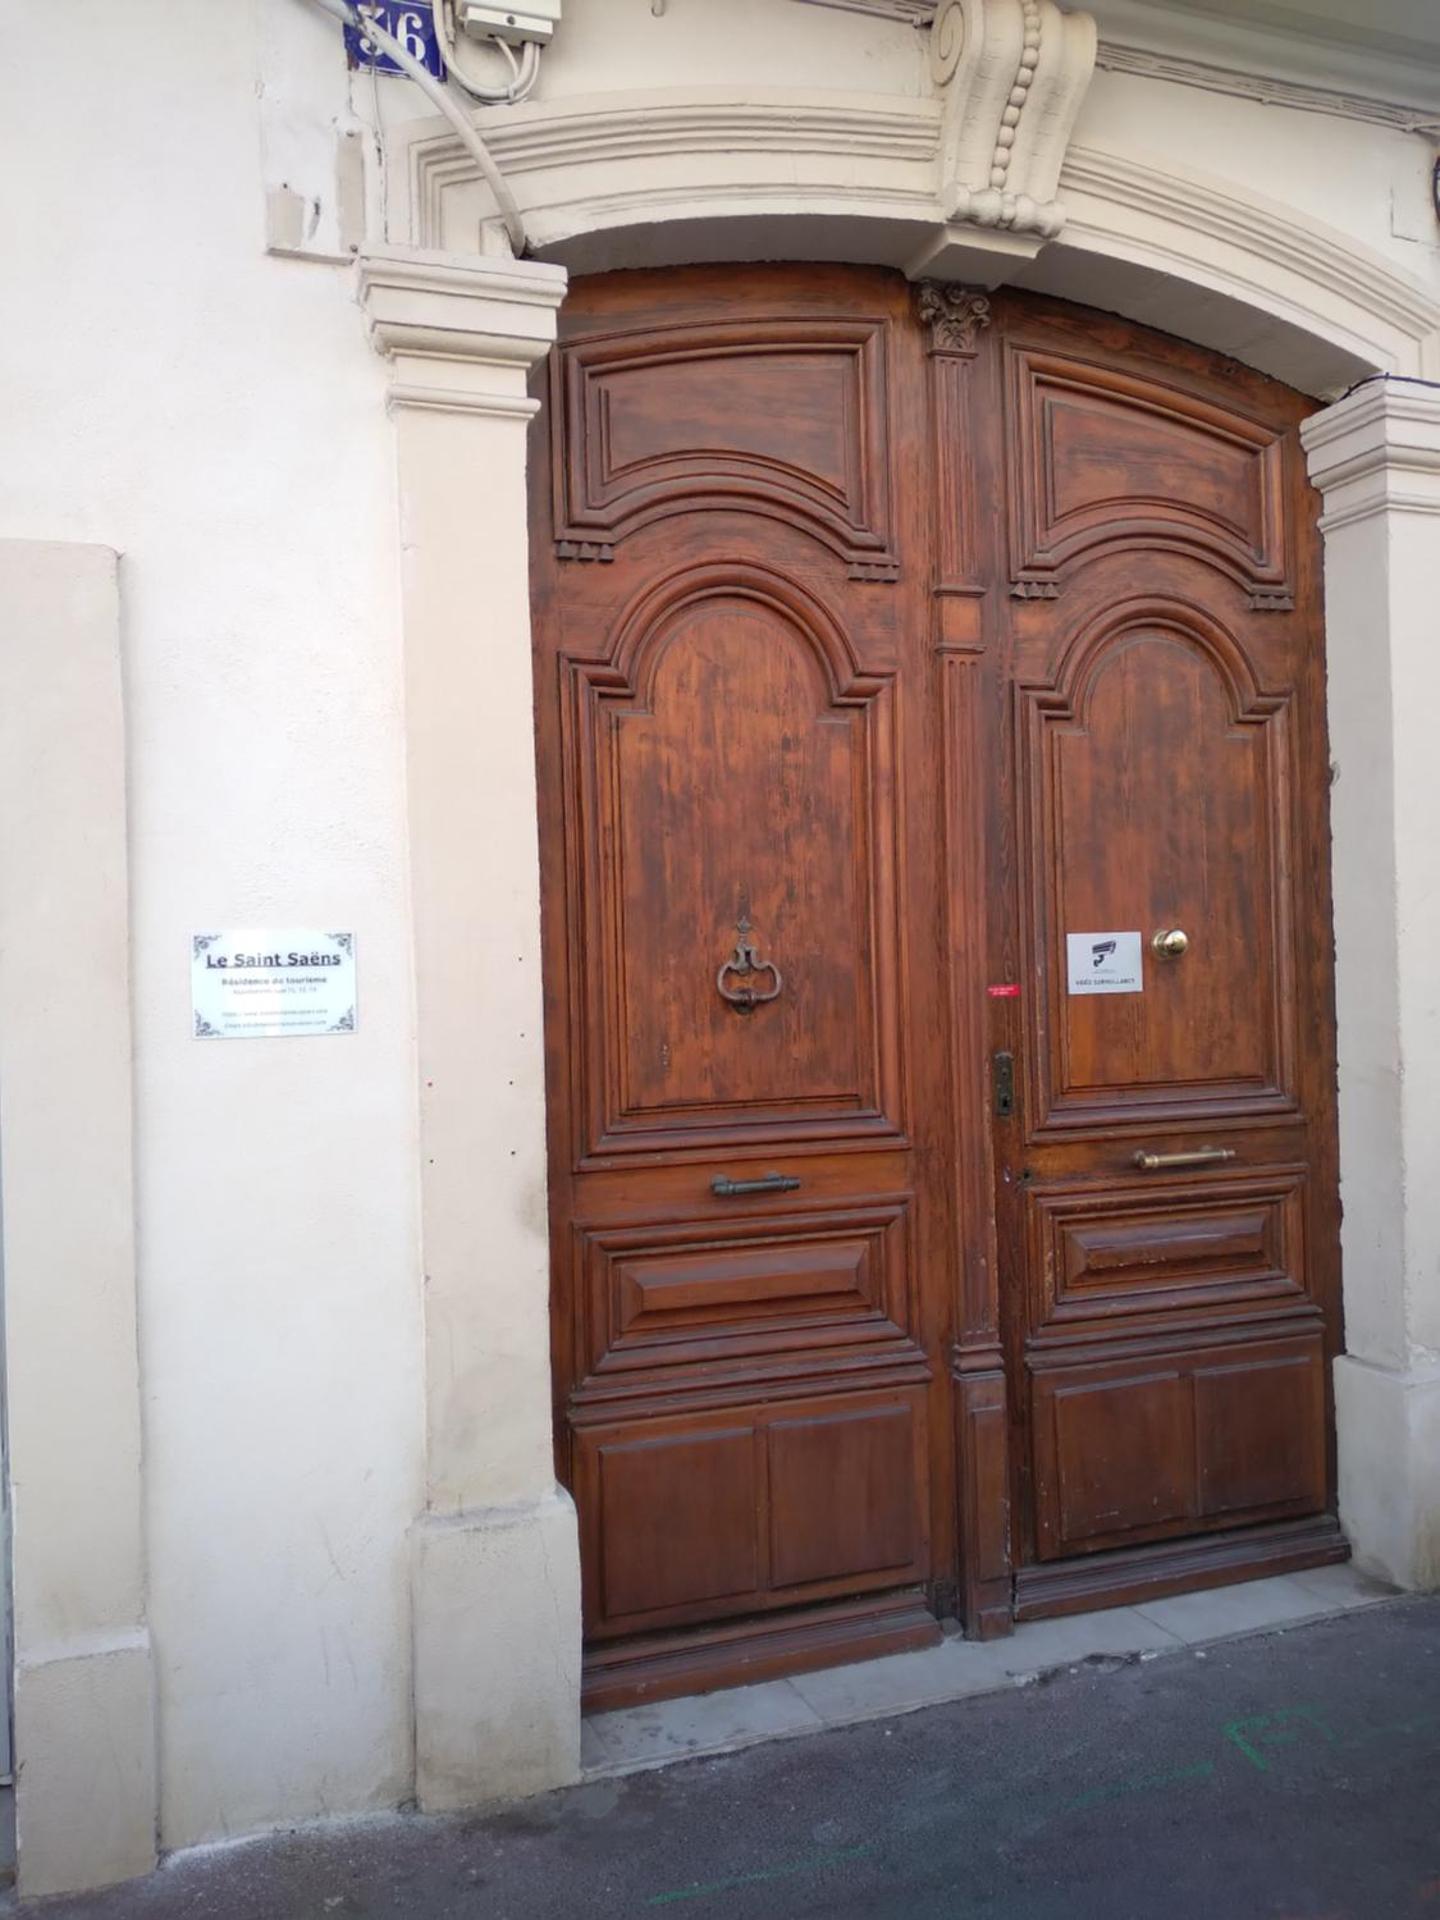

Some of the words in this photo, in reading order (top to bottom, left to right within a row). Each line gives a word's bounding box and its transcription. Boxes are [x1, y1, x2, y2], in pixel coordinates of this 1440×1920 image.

[206, 954, 228, 968] Le
[234, 953, 282, 968] Saint
[288, 952, 341, 967] Saëns
